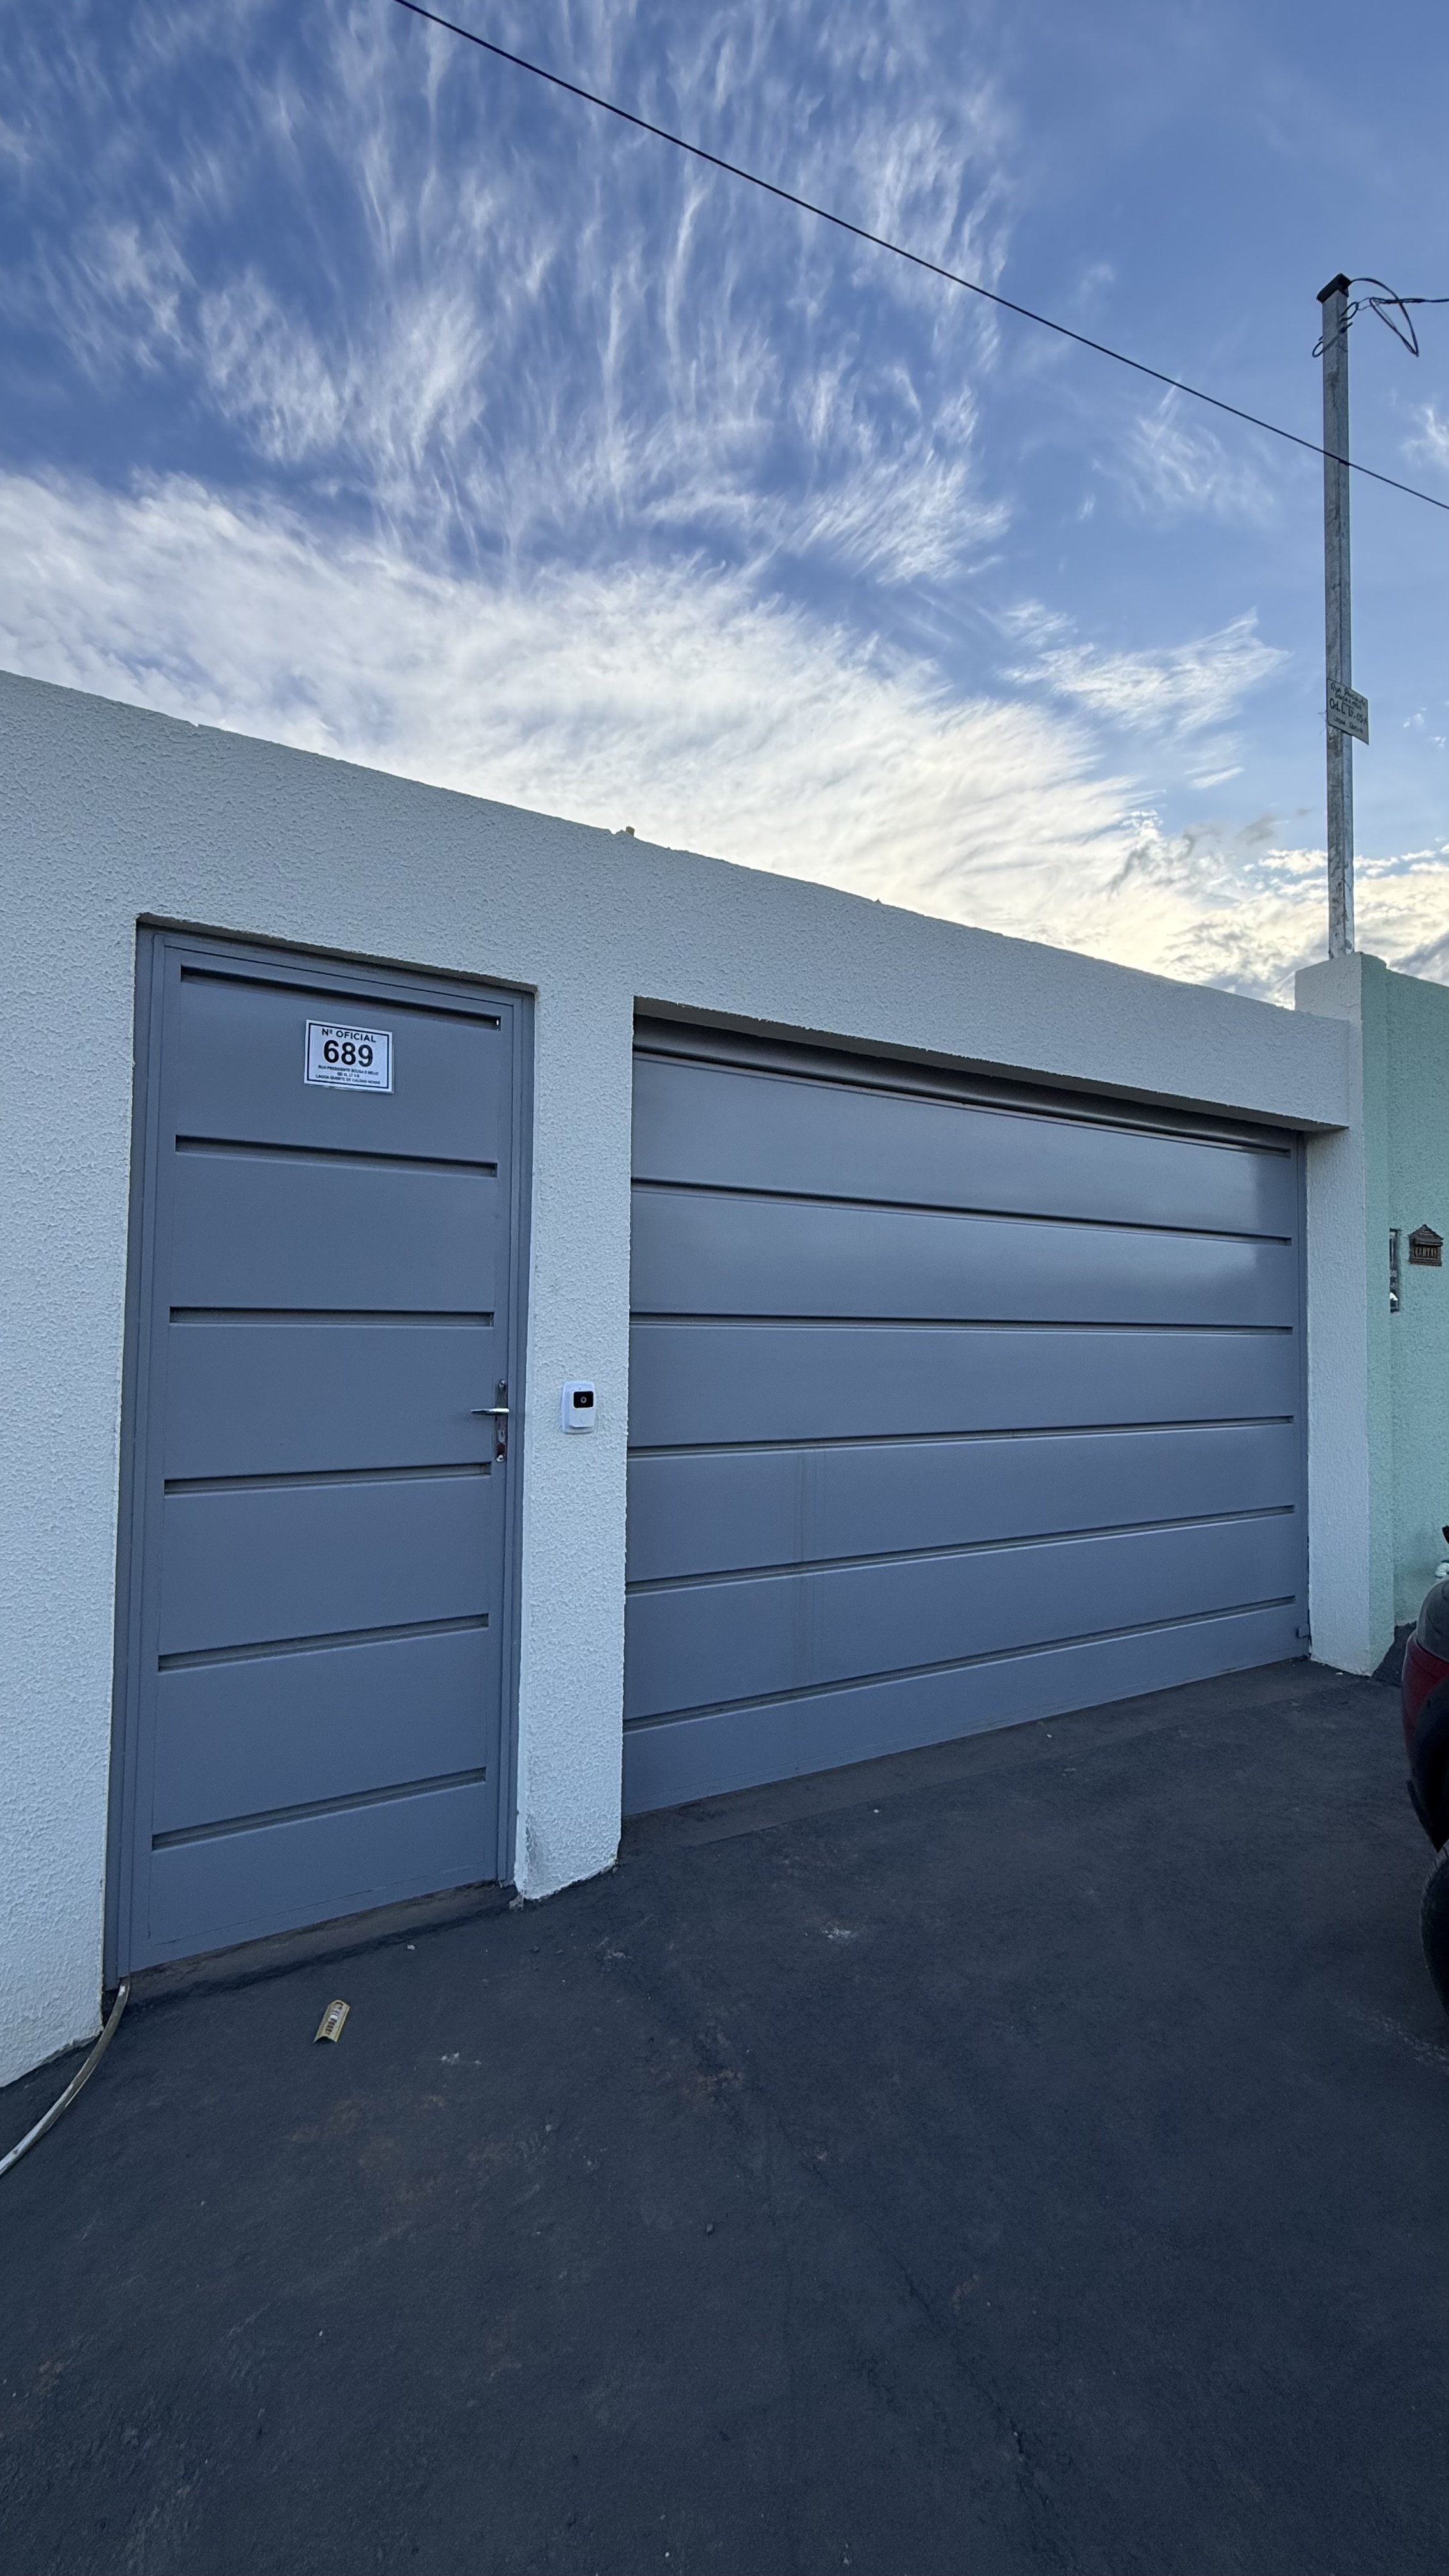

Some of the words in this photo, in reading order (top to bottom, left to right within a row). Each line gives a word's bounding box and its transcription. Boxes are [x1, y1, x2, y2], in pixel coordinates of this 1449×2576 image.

[335, 1030, 376, 1043] OFICIAL
[324, 1039, 373, 1068] 689
[1414, 1246, 1437, 1258] CARTAS
